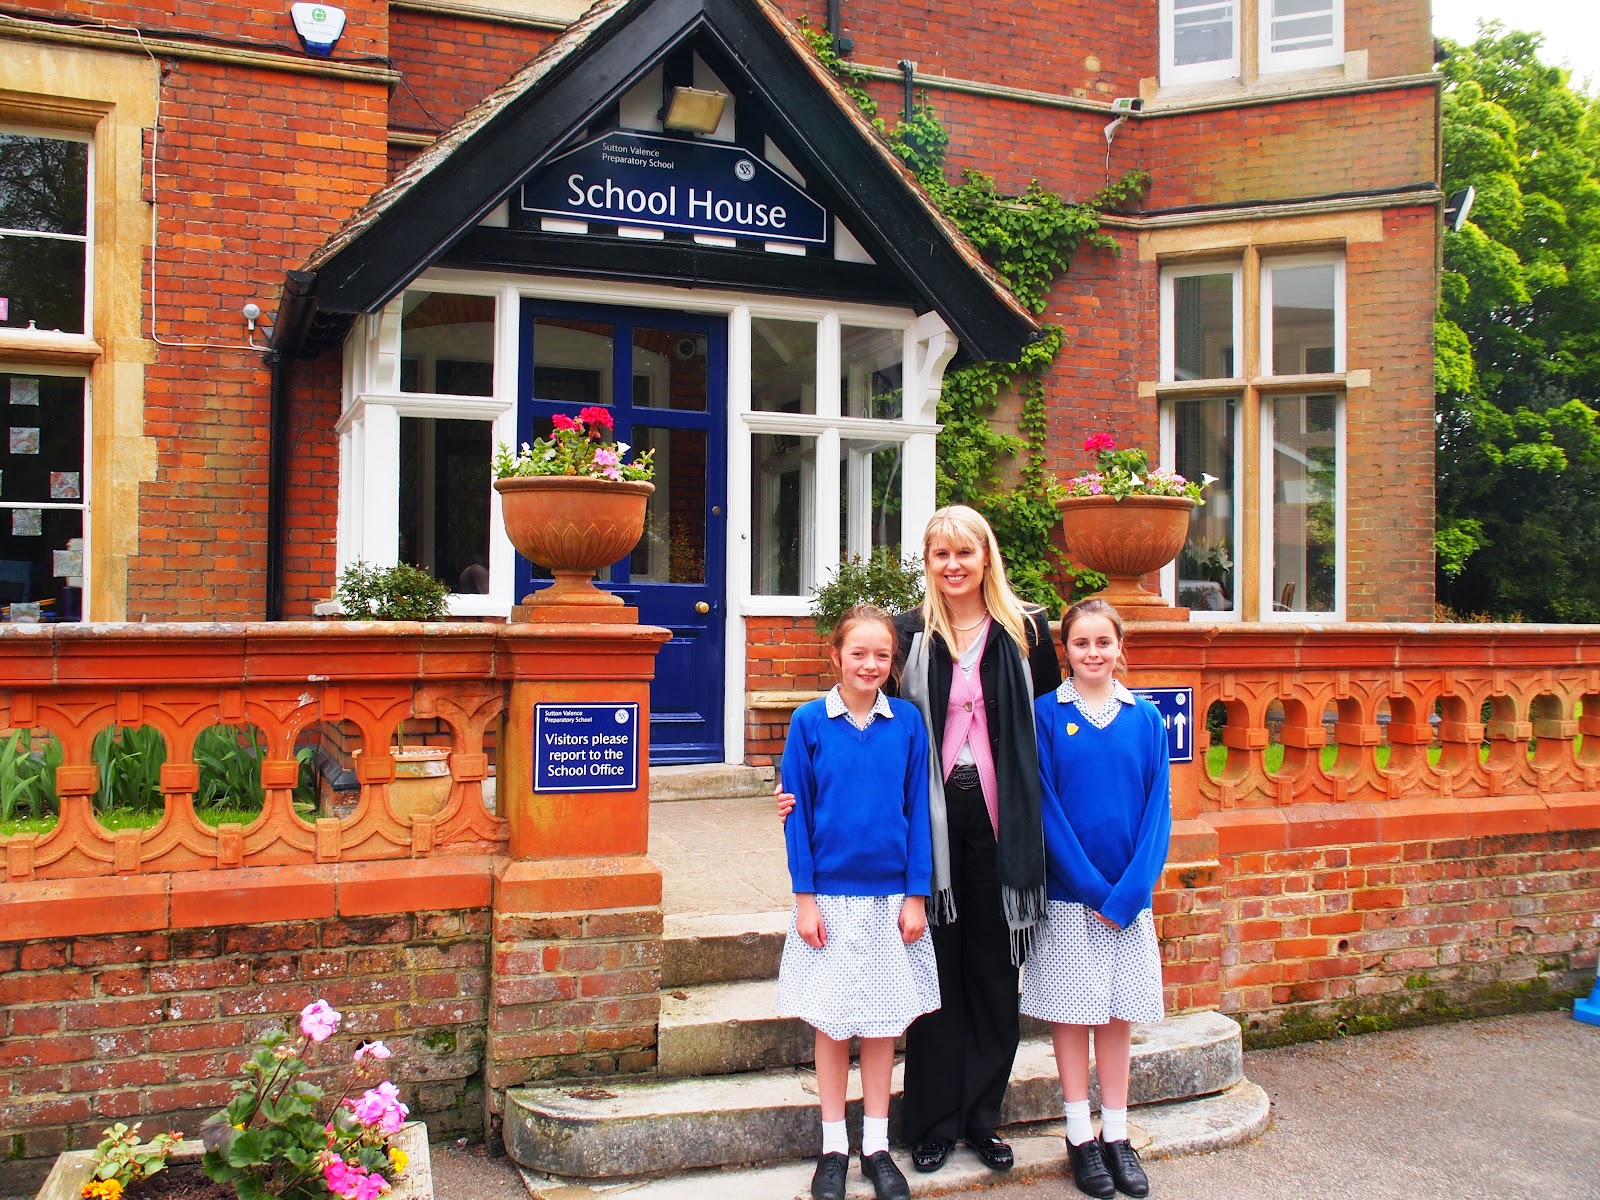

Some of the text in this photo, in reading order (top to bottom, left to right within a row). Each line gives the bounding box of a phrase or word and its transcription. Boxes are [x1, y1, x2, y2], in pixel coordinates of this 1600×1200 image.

[602, 142, 660, 157] Sutton Valence
[602, 153, 675, 170] Preparatory School
[567, 173, 787, 229] School House
[545, 733, 629, 747] Visitors please
[549, 748, 624, 763] report to the
[547, 763, 625, 777] School Office
